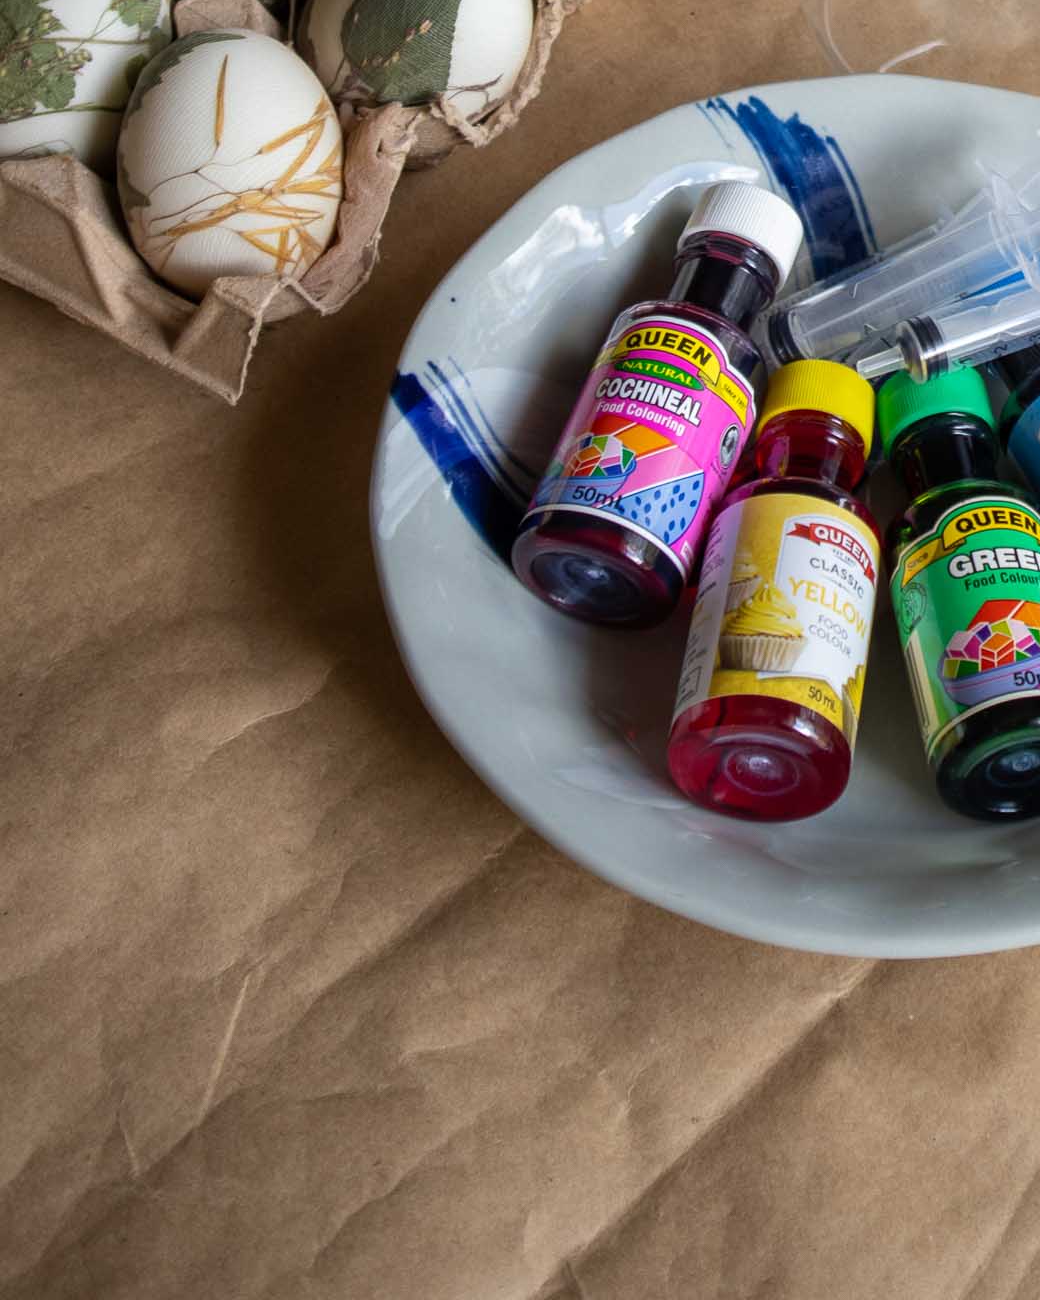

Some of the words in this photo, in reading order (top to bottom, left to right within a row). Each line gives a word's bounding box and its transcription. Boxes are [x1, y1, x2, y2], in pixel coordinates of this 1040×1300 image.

[627, 330, 711, 366] QUEEN
[621, 359, 696, 387] NATURAL
[595, 377, 702, 427] COCHINEAL
[596, 400, 625, 417] Food
[626, 402, 687, 437] Colouring
[955, 510, 1038, 535] QUEEN
[814, 526, 869, 570] QUEEN
[810, 557, 865, 598] CLASSIC
[964, 573, 997, 591] Food
[788, 576, 868, 637] YELLOW
[808, 624, 852, 656] COLOUR
[817, 614, 849, 641] FOOD
[808, 686, 822, 702] 50
